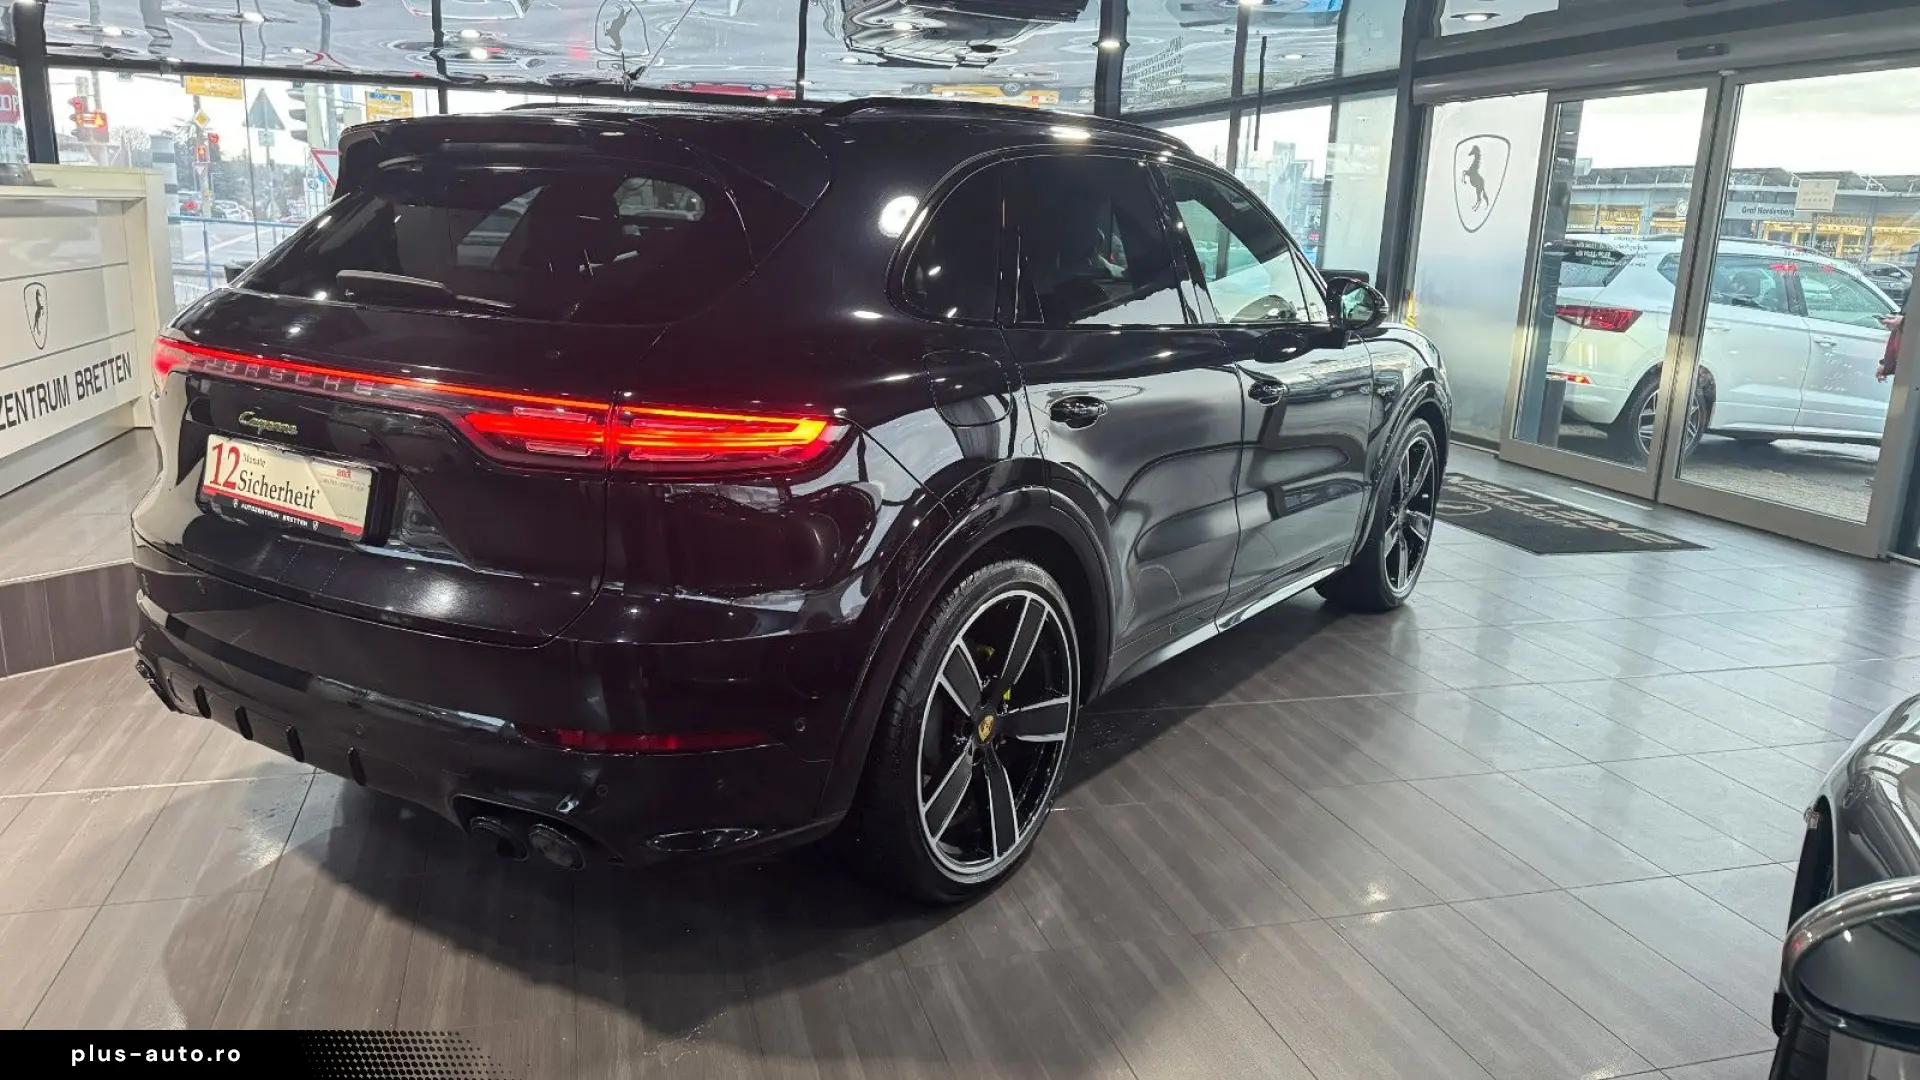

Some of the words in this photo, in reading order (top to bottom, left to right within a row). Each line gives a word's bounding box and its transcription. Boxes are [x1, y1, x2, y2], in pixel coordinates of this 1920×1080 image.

[74, 351, 132, 401] BRETTEN
[202, 354, 376, 396] PORSCHE
[209, 442, 241, 490] 12
[240, 503, 280, 519] AUTOZENTRUM
[282, 514, 308, 527] BRETTEN
